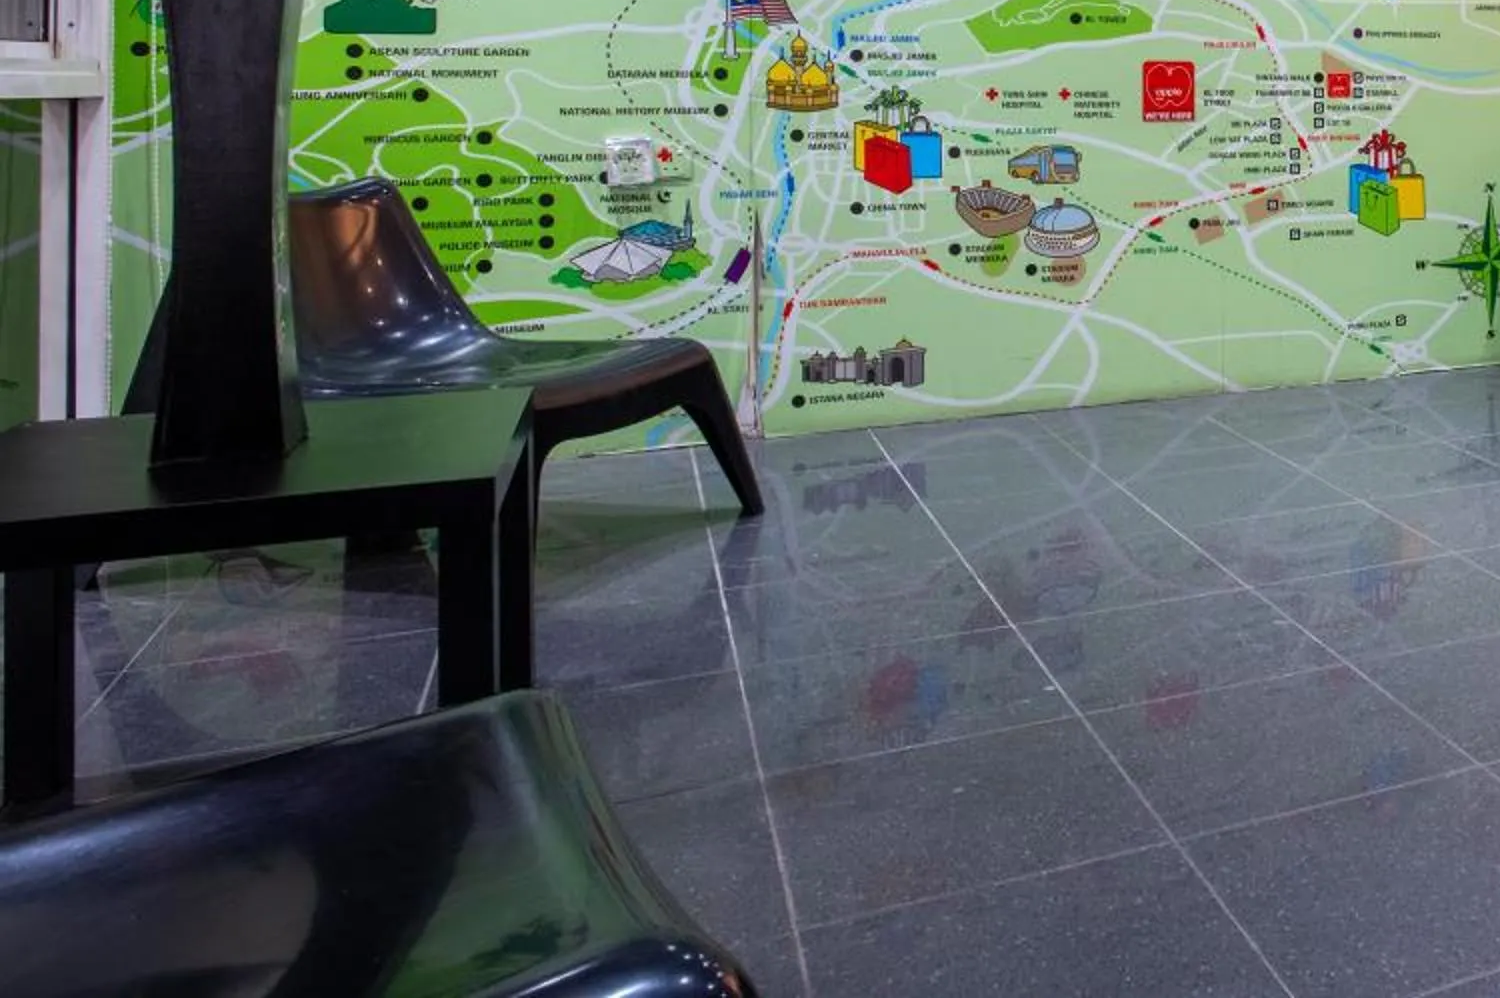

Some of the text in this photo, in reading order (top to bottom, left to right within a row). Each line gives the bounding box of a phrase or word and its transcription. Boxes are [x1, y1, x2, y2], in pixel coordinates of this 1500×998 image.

[369, 45, 530, 58] ASEAN SCULPTURE GARDEN
[369, 67, 499, 80] NATIONAL MONUMENT
[607, 68, 656, 80] DATARAN
[559, 105, 614, 117] NATIONAL
